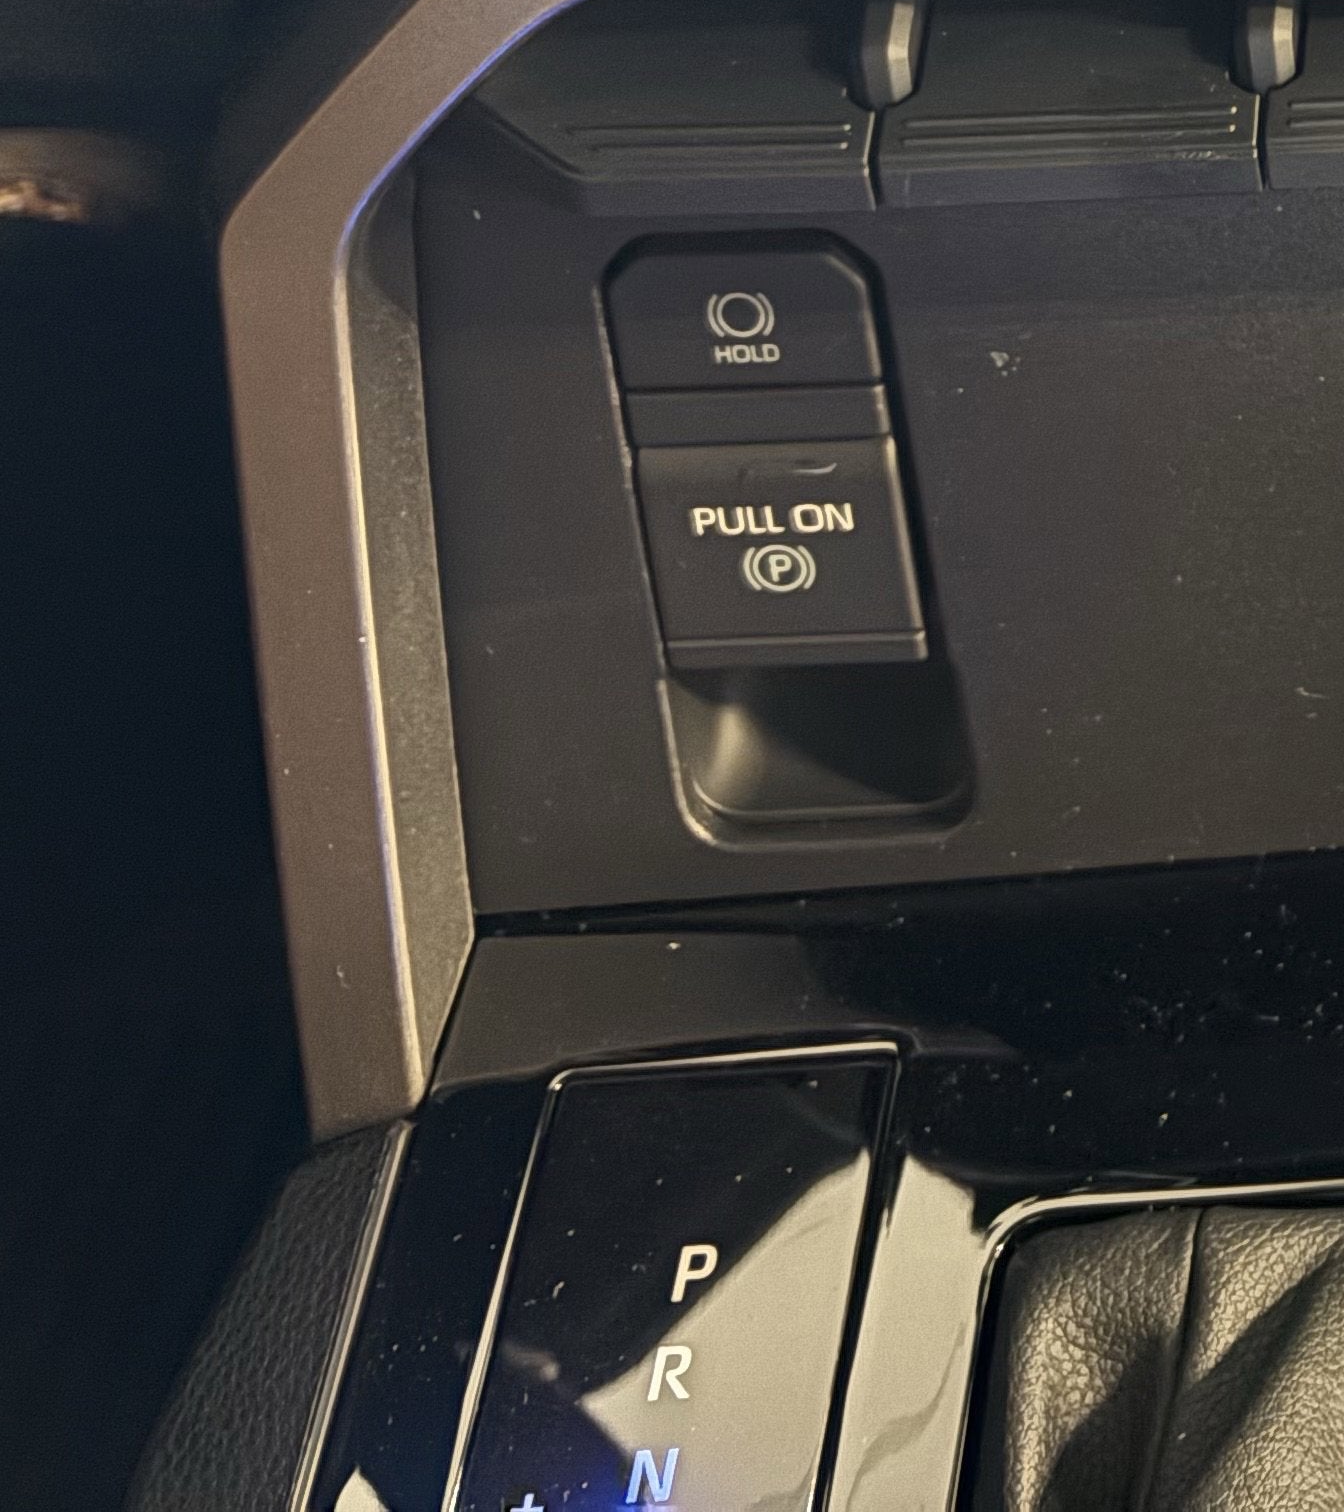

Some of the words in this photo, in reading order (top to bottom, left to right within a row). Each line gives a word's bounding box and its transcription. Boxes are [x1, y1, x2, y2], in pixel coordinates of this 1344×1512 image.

[714, 343, 780, 363] HOLD
[691, 505, 785, 535] PULL
[790, 503, 854, 532] ON
[670, 1245, 718, 1303] P
[647, 1345, 692, 1402] R
[626, 1448, 680, 1504] N
